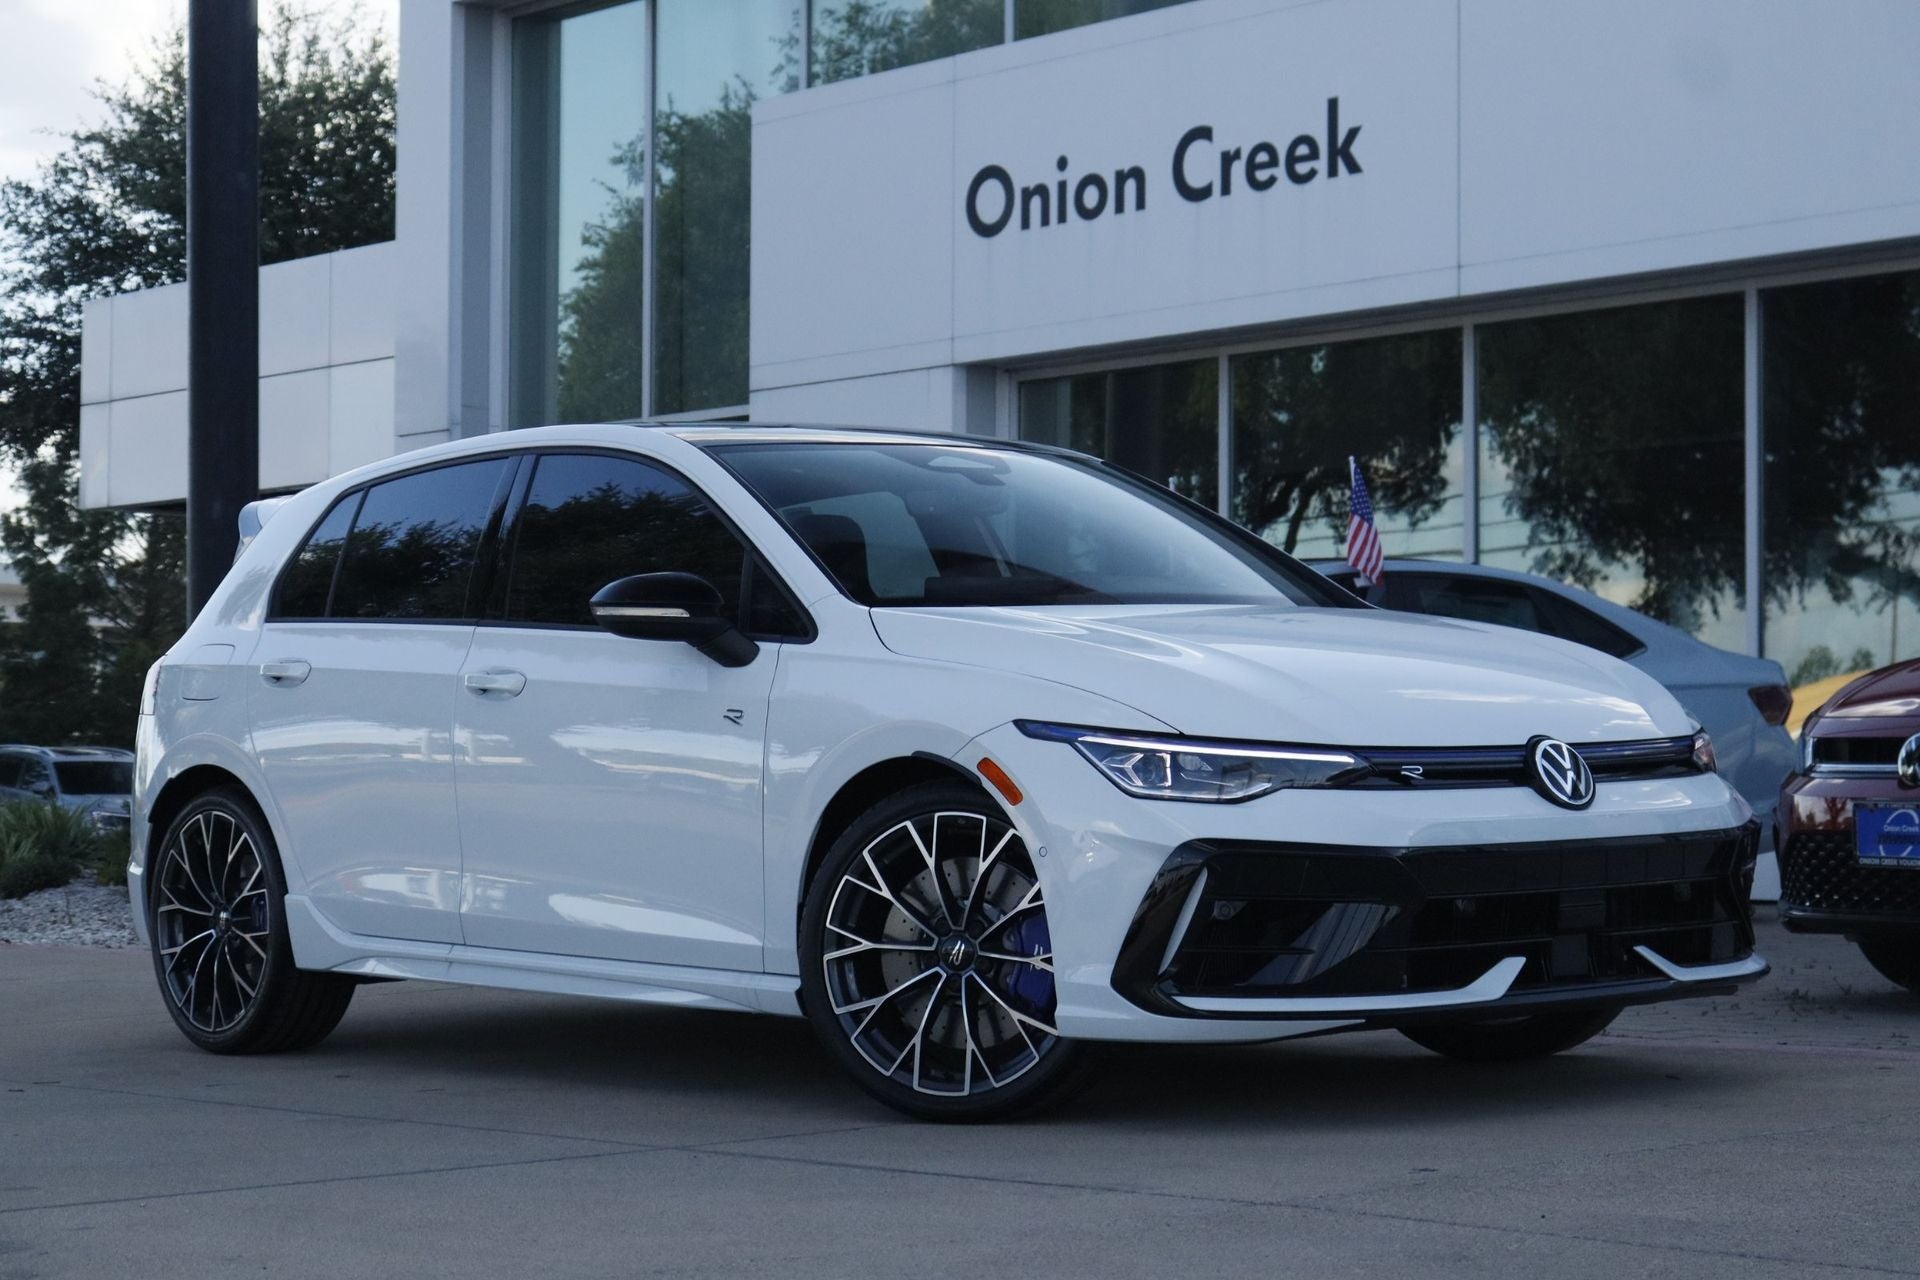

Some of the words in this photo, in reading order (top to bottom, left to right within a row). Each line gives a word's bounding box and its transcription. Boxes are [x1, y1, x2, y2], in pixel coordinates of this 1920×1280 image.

[965, 154, 1147, 239] Onion
[1171, 96, 1364, 203] Creek
[1401, 765, 1424, 779] R
